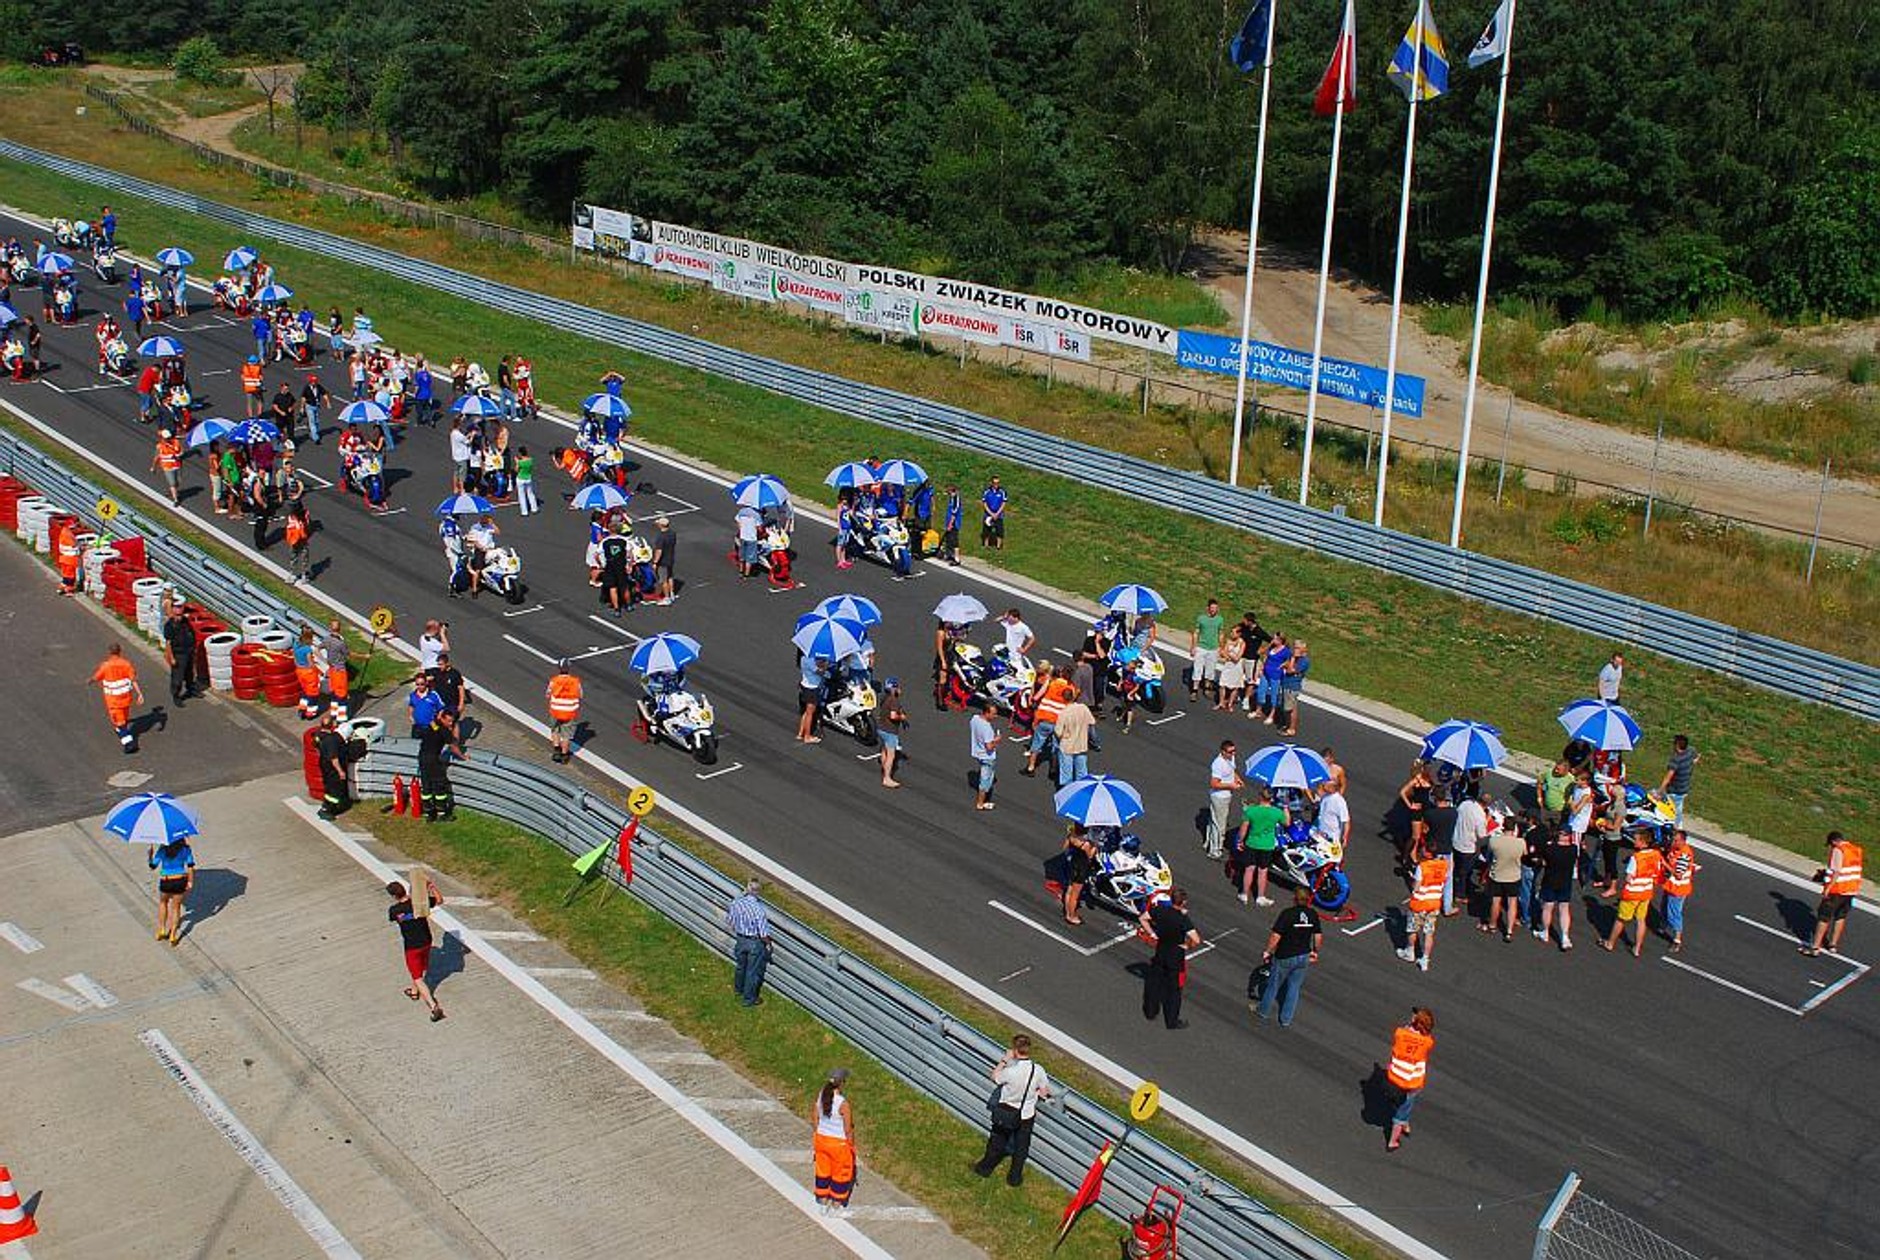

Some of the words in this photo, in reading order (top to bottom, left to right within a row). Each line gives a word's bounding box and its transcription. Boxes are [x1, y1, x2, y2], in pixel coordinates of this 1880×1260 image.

[657, 227, 750, 260] AUTOMOBILKLUB
[756, 246, 846, 282] WIELKOPOLSKI
[859, 269, 926, 293] POLSKI
[936, 283, 1027, 312] ZWIĄZEK
[1035, 301, 1170, 344] MOTOROWY
[788, 281, 842, 303] KERATRONIK
[935, 313, 999, 336] KERATRONIK
[1220, 357, 1250, 372] OPIEI
[1372, 391, 1417, 413] Ponaniu
[633, 793, 649, 810] 2
[1138, 1092, 1151, 1112] 1
